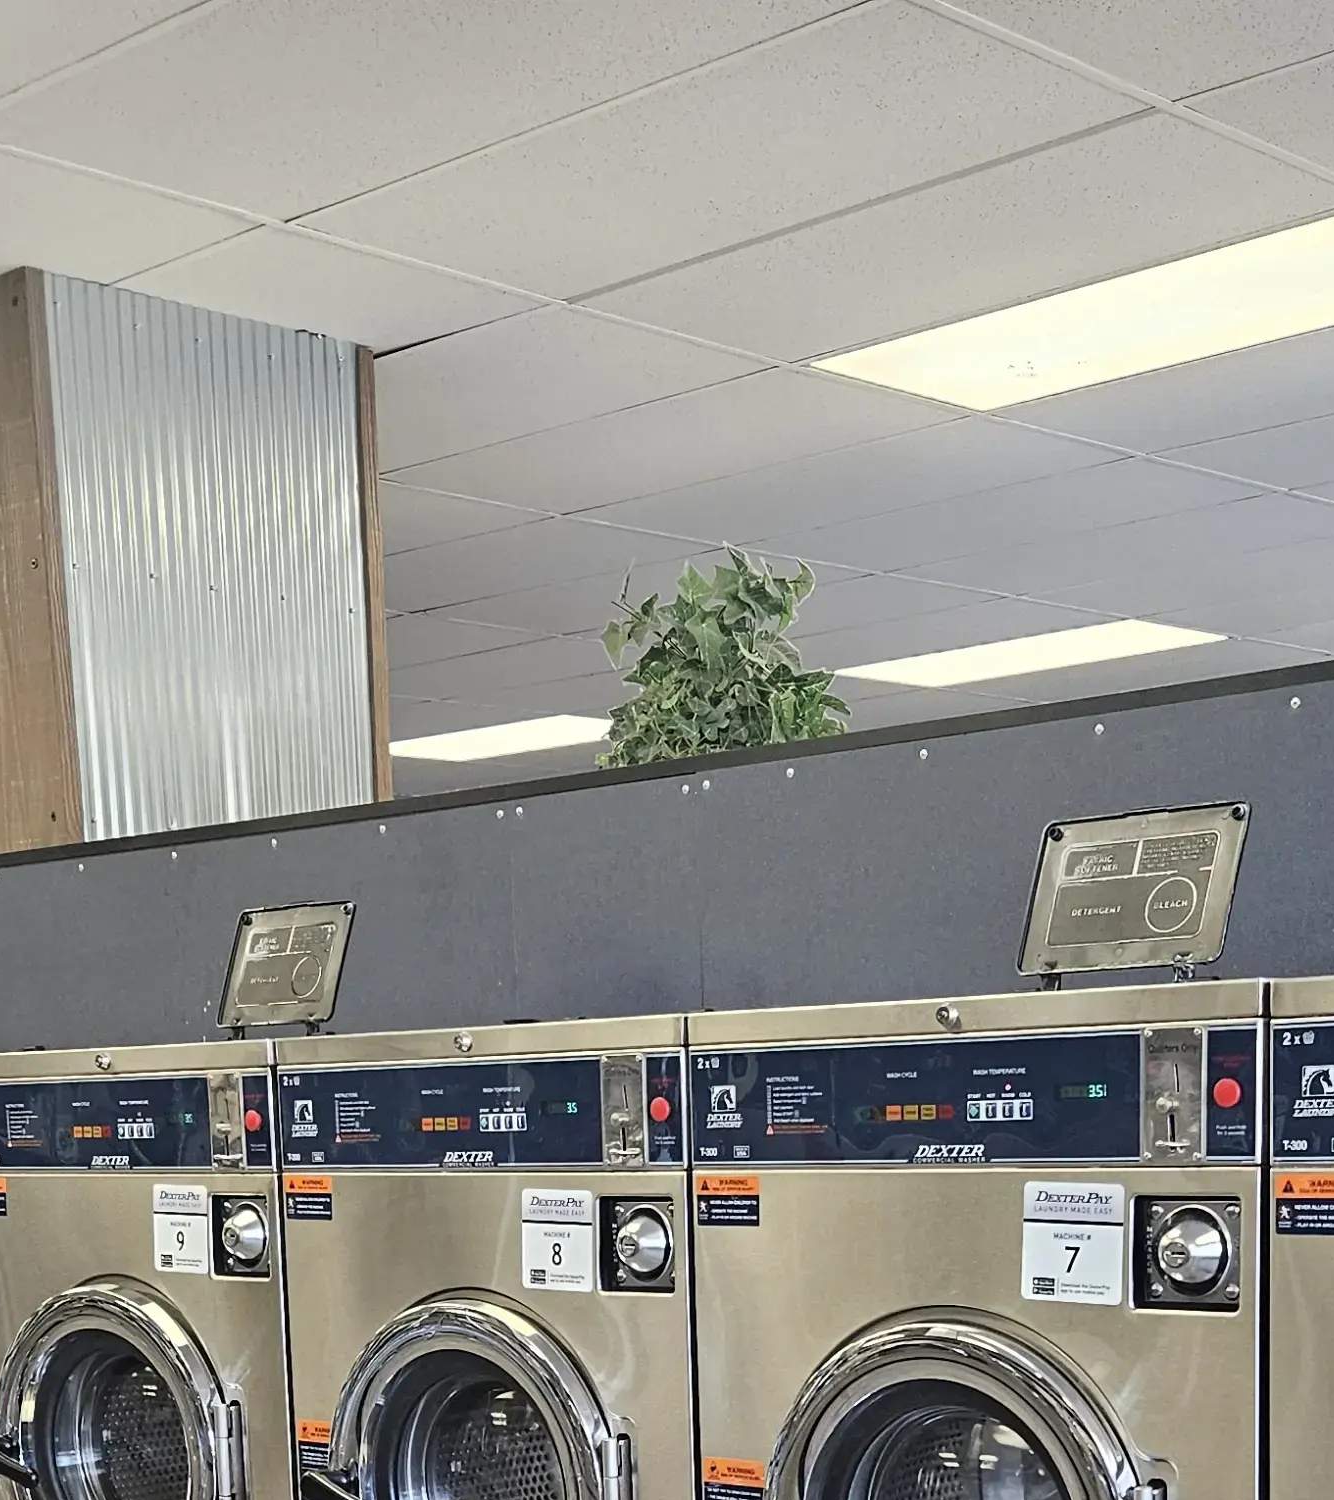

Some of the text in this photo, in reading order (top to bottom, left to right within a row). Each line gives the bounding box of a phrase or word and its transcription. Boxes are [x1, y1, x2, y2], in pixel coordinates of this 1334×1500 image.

[1153, 900, 1187, 910] BLEACH
[1072, 905, 1121, 916] DETERGENT
[1283, 1032, 1291, 1045] 2
[697, 1058, 703, 1069] 2
[282, 1076, 288, 1086] 2
[707, 1113, 743, 1121] DEXTER
[1283, 1140, 1307, 1150] T-300
[699, 1147, 717, 1156] T-300
[914, 1144, 985, 1157] DEXTER
[91, 1155, 130, 1165] DEXTER
[443, 1151, 493, 1162] DEXTER
[1034, 1205, 1113, 1215] LAUNDRY MADE EASY
[176, 1231, 185, 1251] 9
[1053, 1232, 1084, 1241] MACHINE
[552, 1243, 562, 1266] 8
[1064, 1246, 1081, 1274] 7
